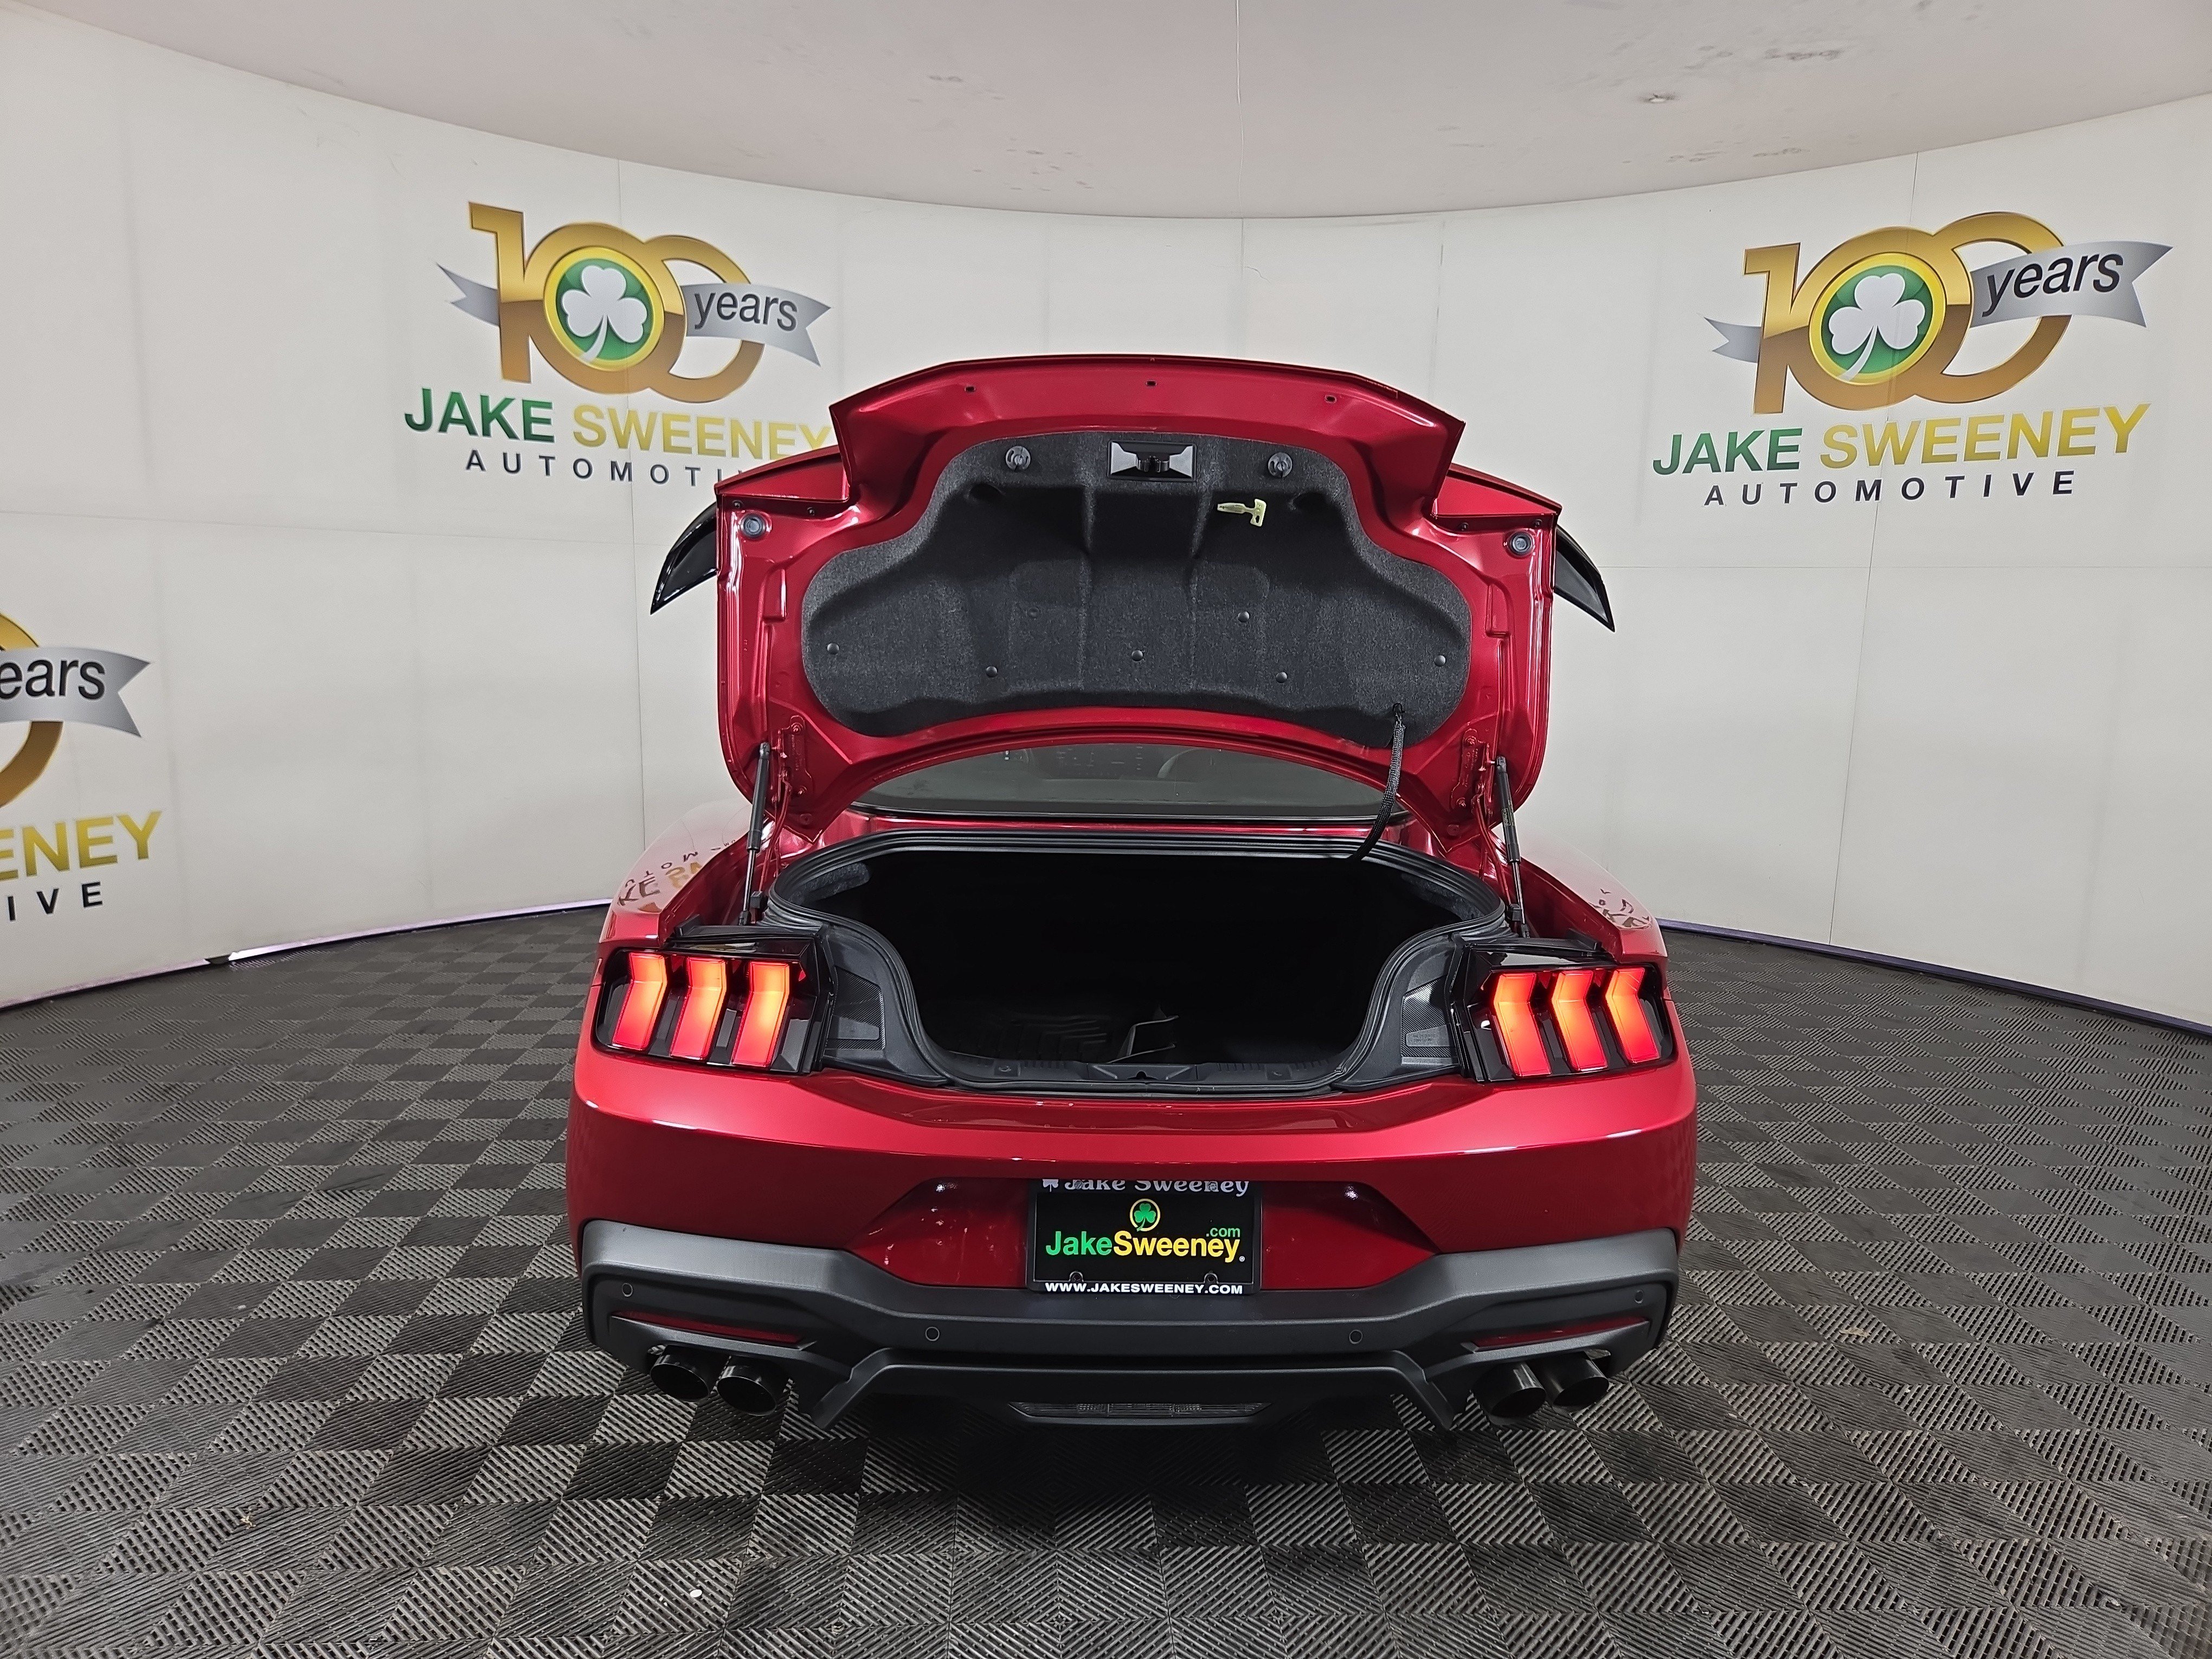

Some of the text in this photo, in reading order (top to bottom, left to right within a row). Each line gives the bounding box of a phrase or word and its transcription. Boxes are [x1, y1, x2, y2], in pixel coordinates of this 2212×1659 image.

[468, 201, 764, 403] 100
[1982, 252, 2123, 317] years
[695, 289, 798, 331] years
[1744, 211, 2072, 414] 100
[404, 388, 832, 460] JAKE SWEENEY
[1652, 403, 2151, 475] JAKE SWEENEY
[466, 449, 743, 486] AUTOMOTI
[1703, 471, 2074, 506] AUTOMOTIVE
[0, 658, 106, 700] ears
[8, 881, 102, 921] IVE
[1134, 1180, 1249, 1197] Sweeney
[1045, 1282, 1243, 1295] WWW.JAKESWEENEY.COM
